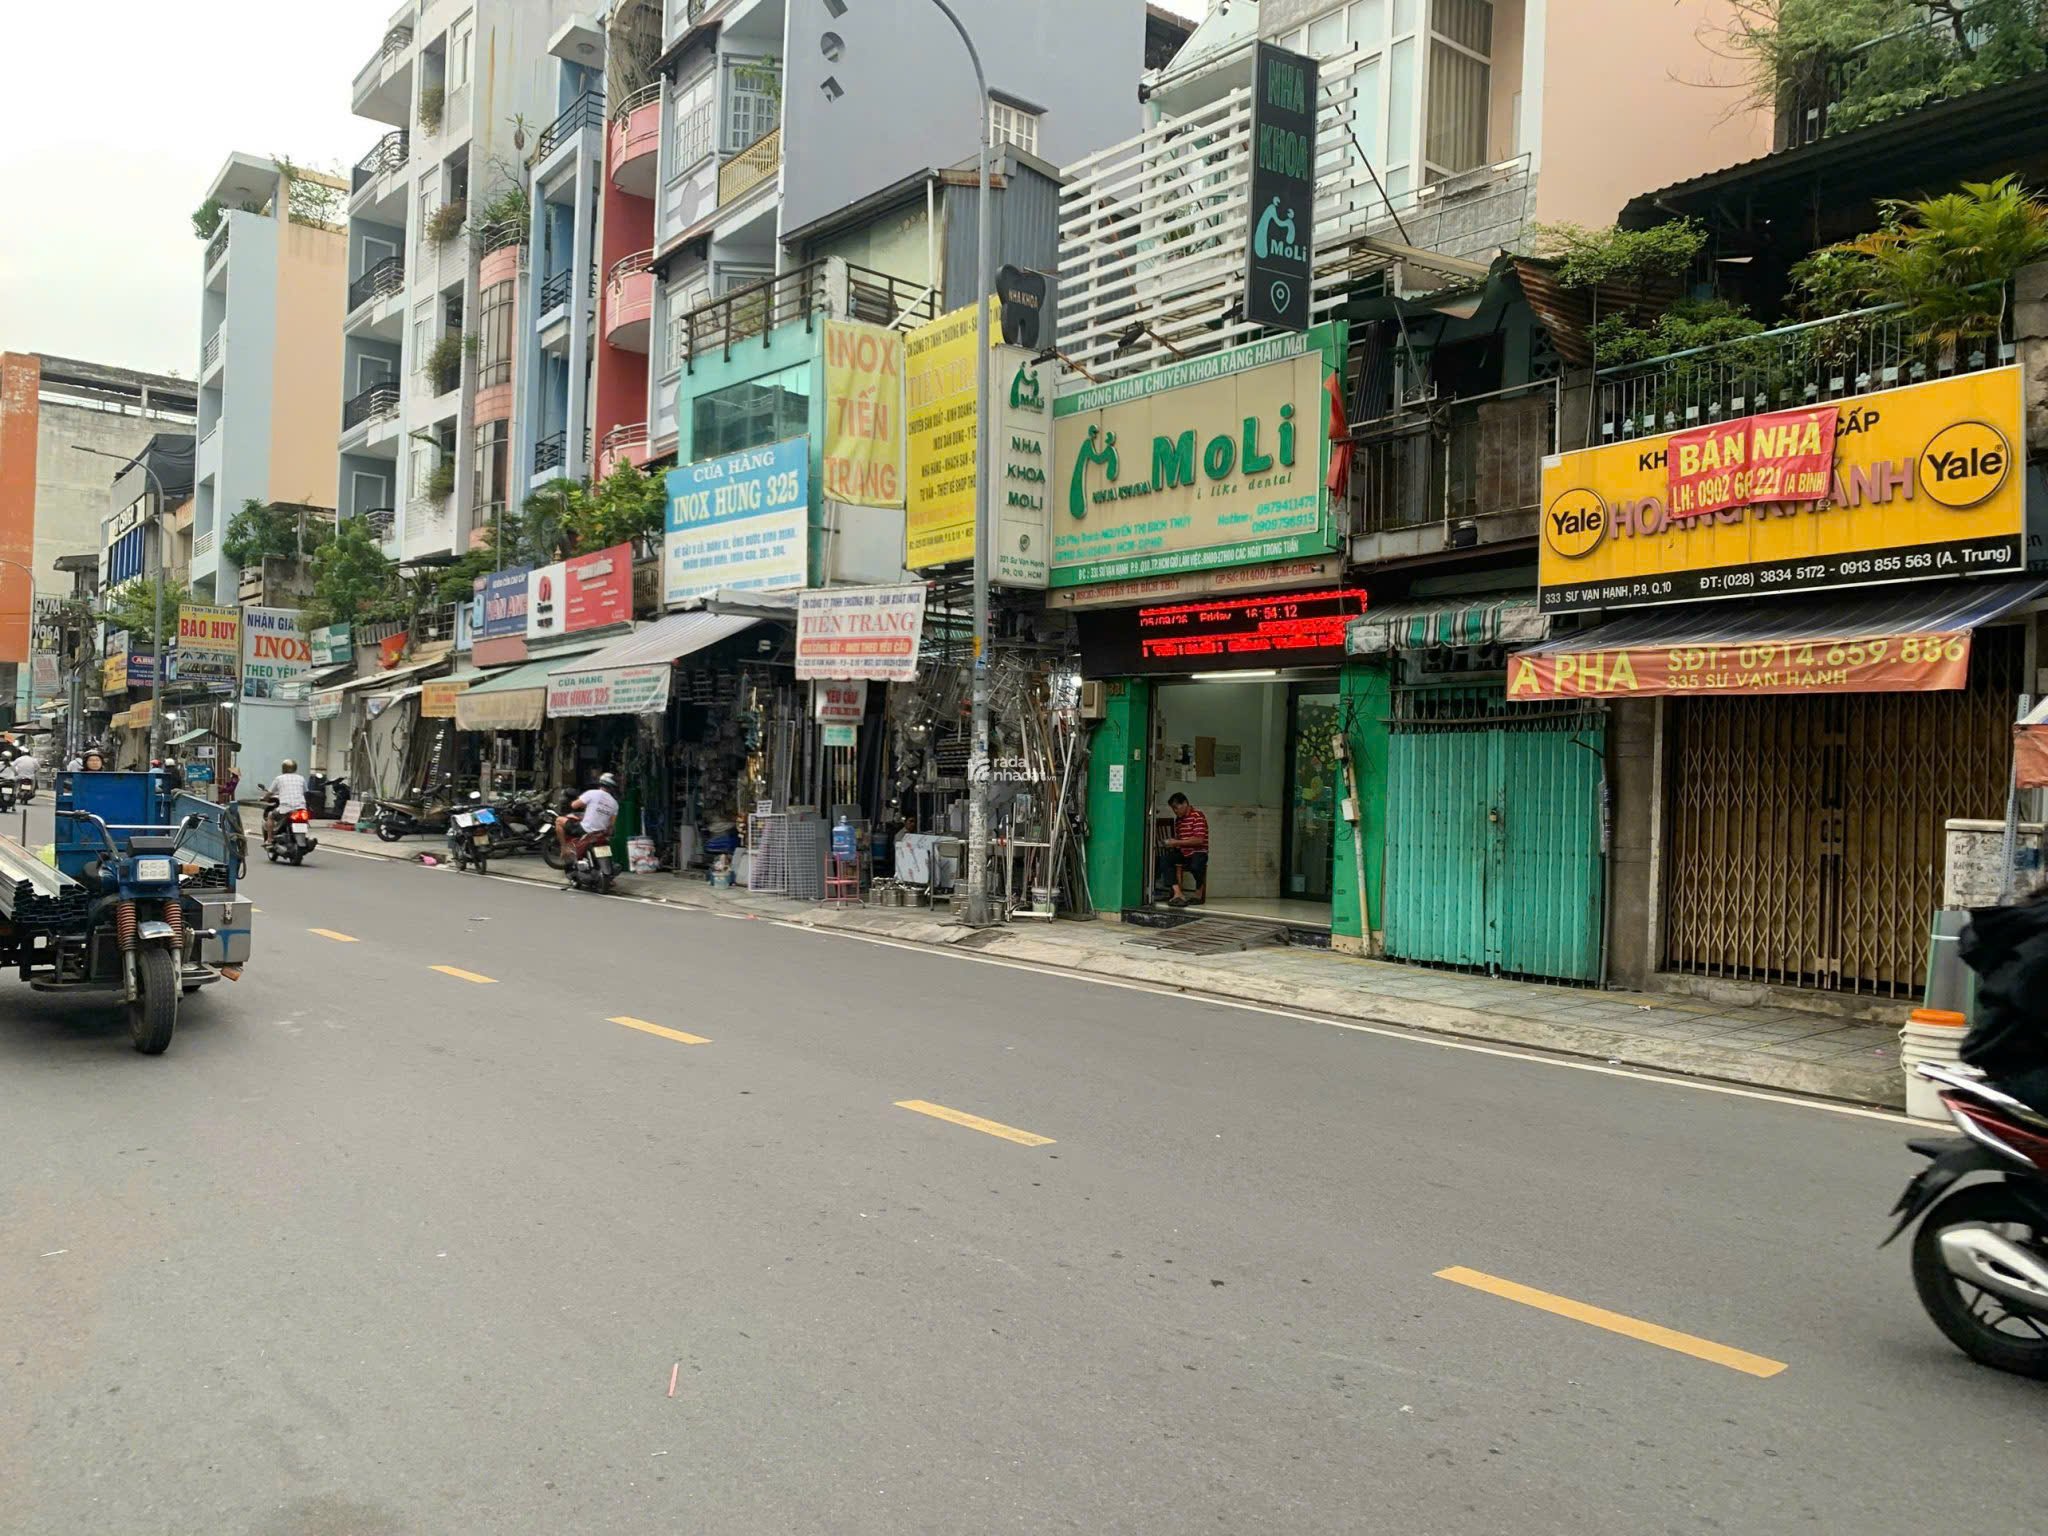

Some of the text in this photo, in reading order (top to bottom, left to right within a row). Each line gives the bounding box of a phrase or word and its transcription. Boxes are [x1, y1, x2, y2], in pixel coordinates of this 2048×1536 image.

[1267, 58, 1305, 115] NHA
[1259, 122, 1309, 181] KHOA
[1270, 238, 1307, 263] MoLi
[828, 328, 896, 376] INOX
[1077, 388, 1112, 411] PHÒNG
[1113, 377, 1144, 402] KHÁM
[1145, 365, 1188, 393] CHUYÊN
[1189, 361, 1219, 383] KHOA
[837, 386, 887, 441] TIẾN
[1011, 436, 1042, 456] NHA
[1152, 403, 1296, 491] MoLi
[1679, 413, 1823, 478] BÁN NHÀ
[728, 451, 775, 475] HÀNG
[1007, 463, 1046, 485] KHOA
[1639, 450, 1668, 472] KH
[1926, 447, 2003, 482] Yale
[825, 456, 896, 499] TRANG
[1211, 483, 1238, 497] like
[1248, 472, 1292, 490] dental
[1672, 484, 1695, 514] LH:
[1698, 474, 1730, 508] 0902
[1753, 466, 1782, 496] 221
[1784, 472, 1795, 496] (A
[1797, 469, 1827, 494] BÌNH)
[673, 470, 799, 525] INOX HÙNG 325
[1008, 491, 1044, 512] MOLI
[1551, 507, 1602, 536] Yale
[1027, 570, 1042, 580] HCM
[1760, 569, 1792, 584] 3834
[1796, 565, 1826, 581] 5172
[1840, 560, 1871, 576] 0913
[1874, 556, 1901, 573] 855
[1904, 553, 1932, 569] 563
[1936, 551, 1958, 569] (A.
[1962, 545, 2012, 564] Trung)
[34, 598, 61, 615] GYM
[1545, 592, 1561, 605] 333
[1565, 590, 1580, 603] SƯ
[1582, 588, 1600, 603] VẠN
[1602, 585, 1632, 601] HẠNH,
[1651, 581, 1672, 595] Q.10
[34, 624, 60, 641] YOGA
[180, 612, 237, 640] BẢO HUY
[247, 612, 275, 632] NHẬN
[277, 616, 294, 632] GIA
[801, 608, 842, 634] TIẾN
[254, 634, 312, 662] INOX
[245, 663, 273, 678] THEO
[1509, 636, 1965, 695] A PHA SĐT: 0914.659.886
[1666, 668, 1848, 691] 335 SƯ VẠN HẠNH
